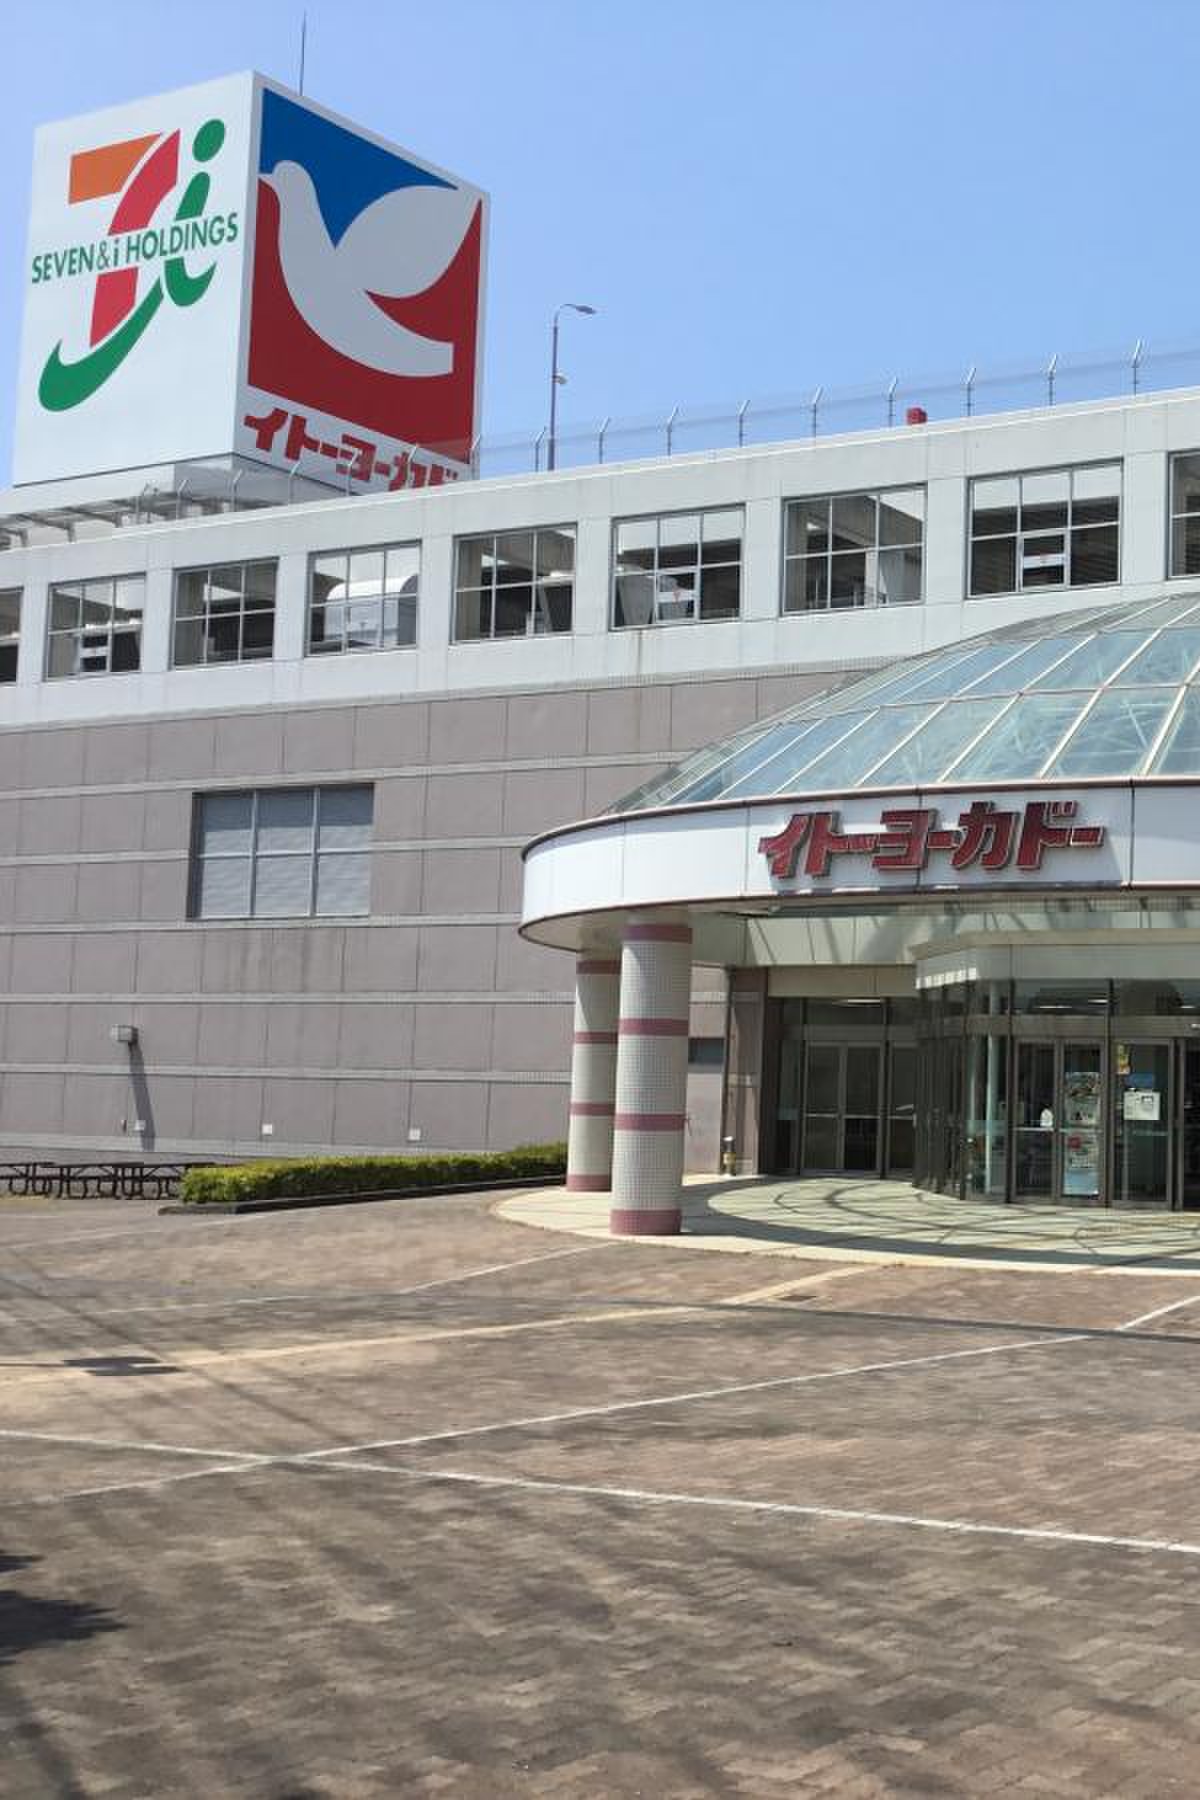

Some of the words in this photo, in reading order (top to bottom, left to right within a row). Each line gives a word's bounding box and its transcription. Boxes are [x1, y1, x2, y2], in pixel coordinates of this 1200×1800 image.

[126, 212, 239, 263] HOLDINGS
[244, 408, 458, 492] イトーヨーカド
[758, 800, 1105, 880] イトーヨーカドー
